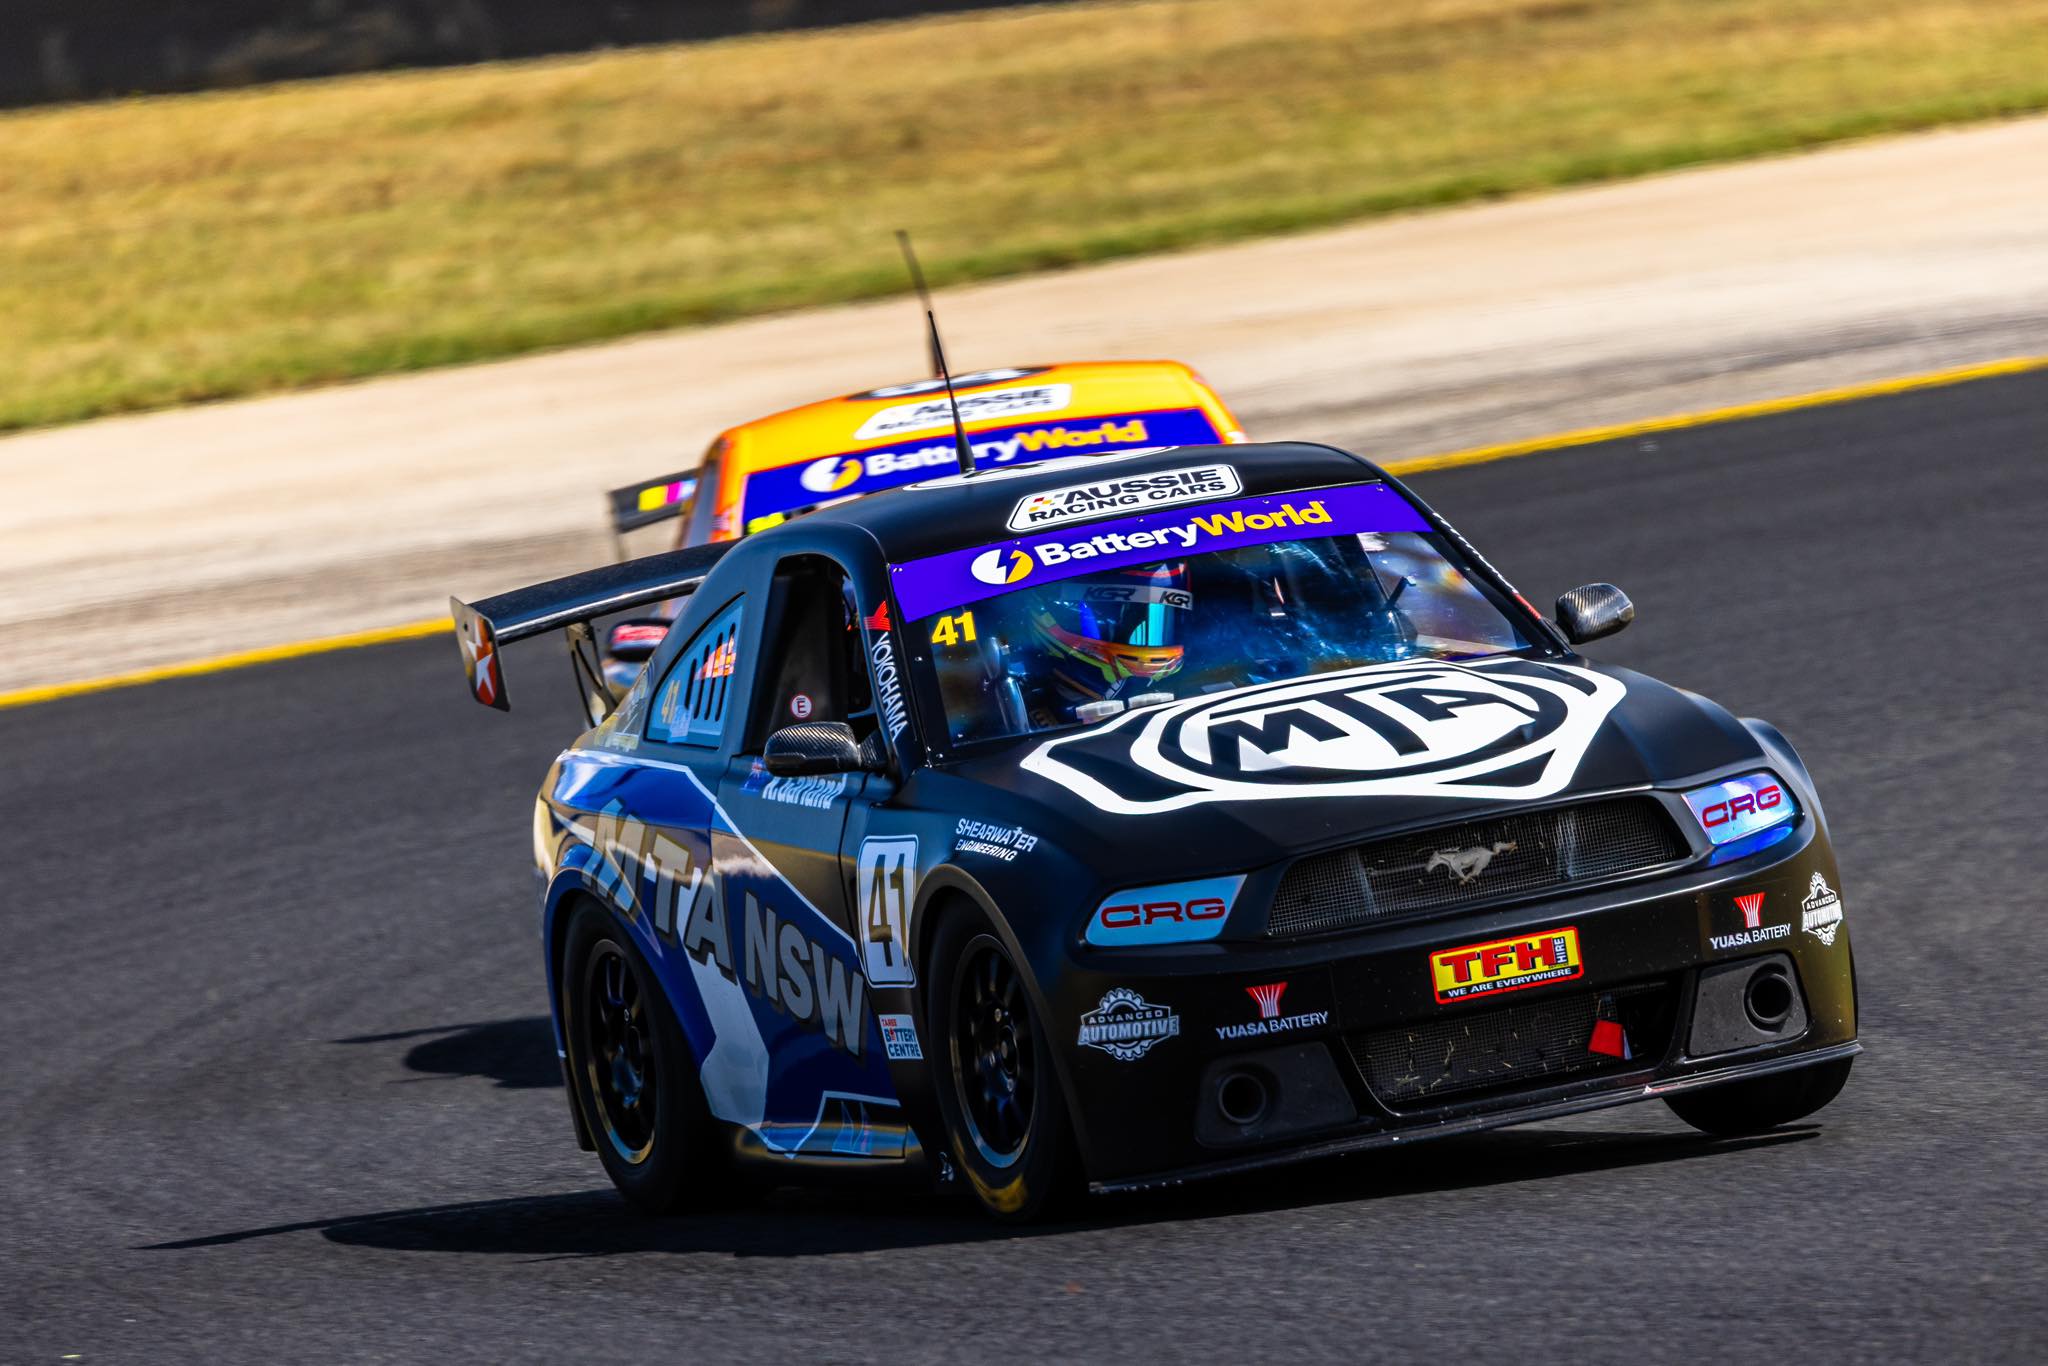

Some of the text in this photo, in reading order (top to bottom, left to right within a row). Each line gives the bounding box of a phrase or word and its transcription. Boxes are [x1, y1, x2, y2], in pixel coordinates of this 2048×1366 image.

[1028, 481, 1227, 522] RACING CARS
[1061, 468, 1220, 505] AUSSIE
[1034, 502, 1333, 566] BatteryWorld
[931, 611, 977, 646] 41
[871, 631, 908, 742] YOKOHAMA
[1702, 785, 1781, 828] CRG
[955, 818, 1038, 852] SHEARWATER
[955, 839, 1018, 861] ENGINEERING
[580, 798, 737, 972] MTA
[868, 853, 908, 967] 41
[1101, 898, 1226, 928] CRG
[1806, 895, 1835, 910] ADVANCED
[1554, 937, 1566, 964] HIRE
[1709, 924, 1791, 949] YUASA BATTERY
[744, 892, 864, 1057] NSW
[1439, 938, 1556, 983] TFH
[1448, 968, 1572, 998] WE ARE EVERYWHERE
[1080, 1017, 1178, 1044] AUTOMOTIVE
[1089, 1010, 1163, 1025] ADVANCED
[1216, 1011, 1328, 1040] YUASA BATTERY
[888, 1043, 921, 1057] CENTRE
